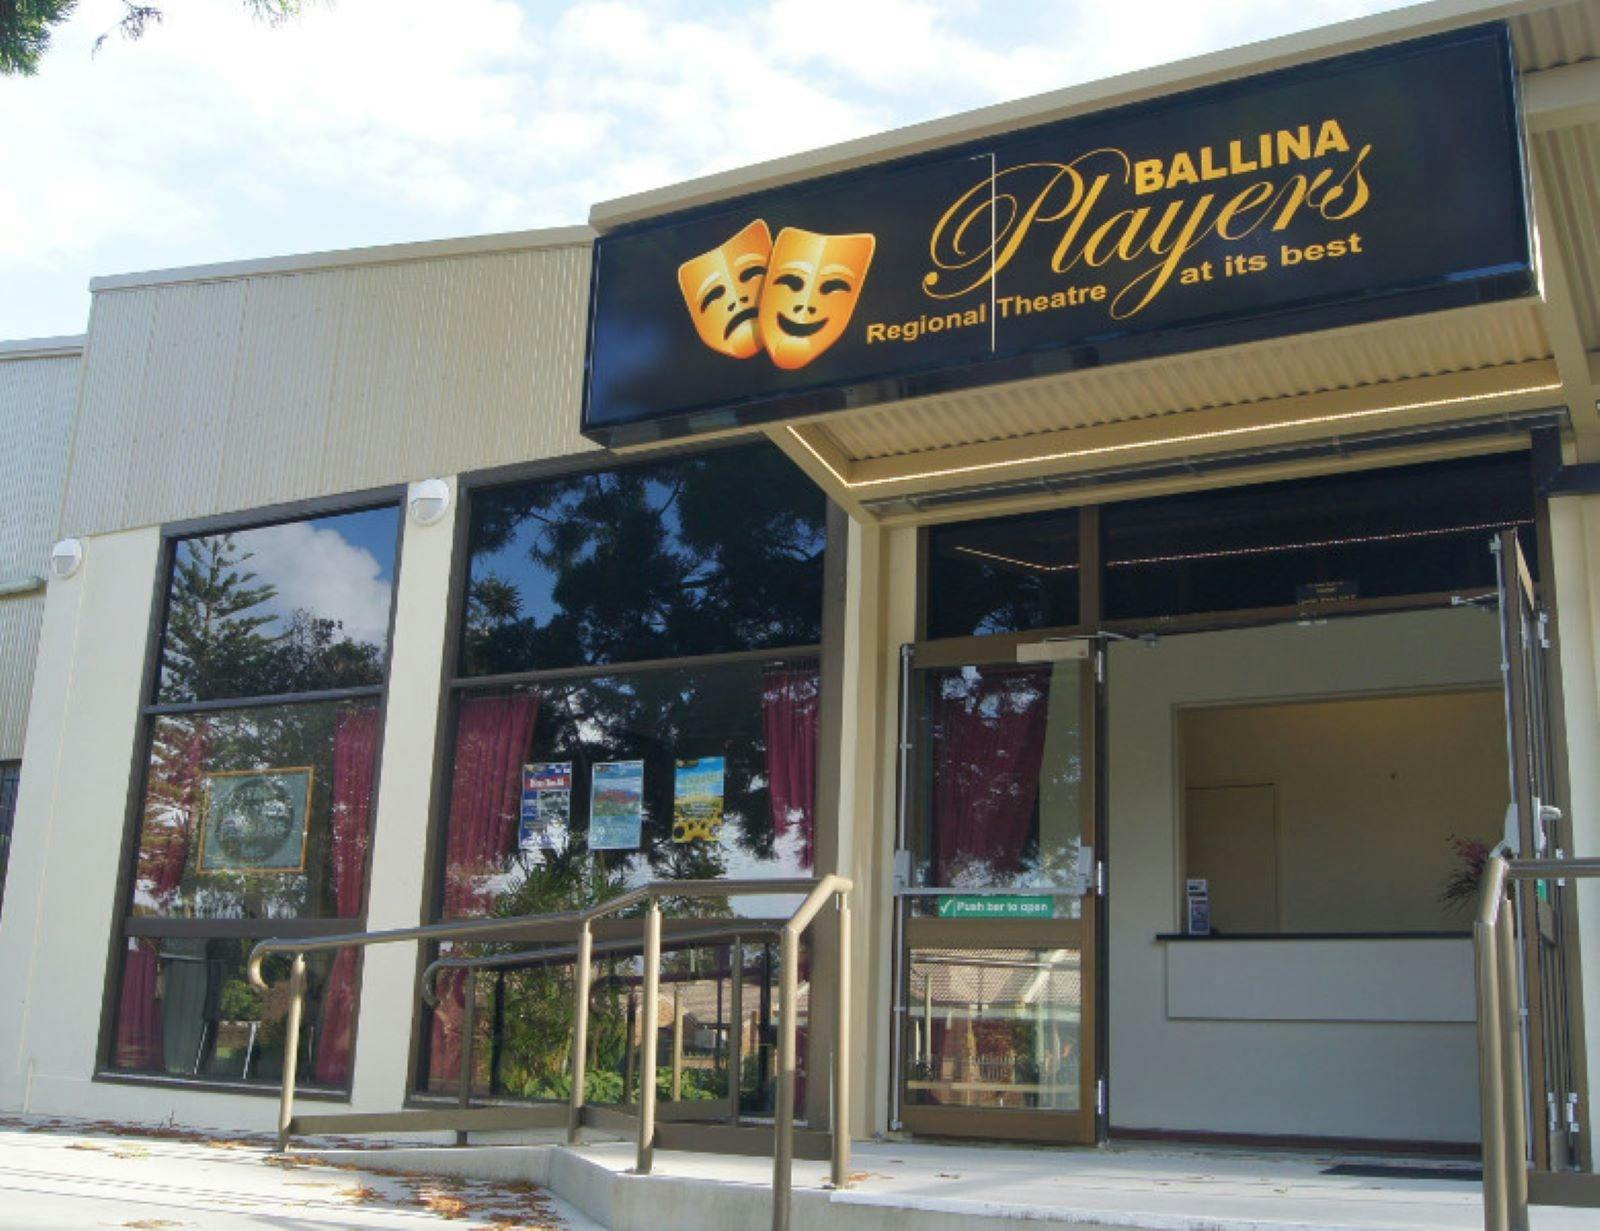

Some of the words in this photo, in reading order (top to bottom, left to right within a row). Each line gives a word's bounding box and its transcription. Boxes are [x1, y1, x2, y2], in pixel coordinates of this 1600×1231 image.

[1134, 117, 1350, 196] BALLINA
[921, 143, 1372, 321] Players
[866, 302, 987, 345] Regional
[996, 283, 1107, 318] Theatre
[1180, 260, 1214, 285] at
[1225, 253, 1268, 278] its
[1281, 232, 1363, 267] best
[956, 901, 985, 912] Push
[1008, 902, 1018, 912] to
[1020, 902, 1048, 914] open
